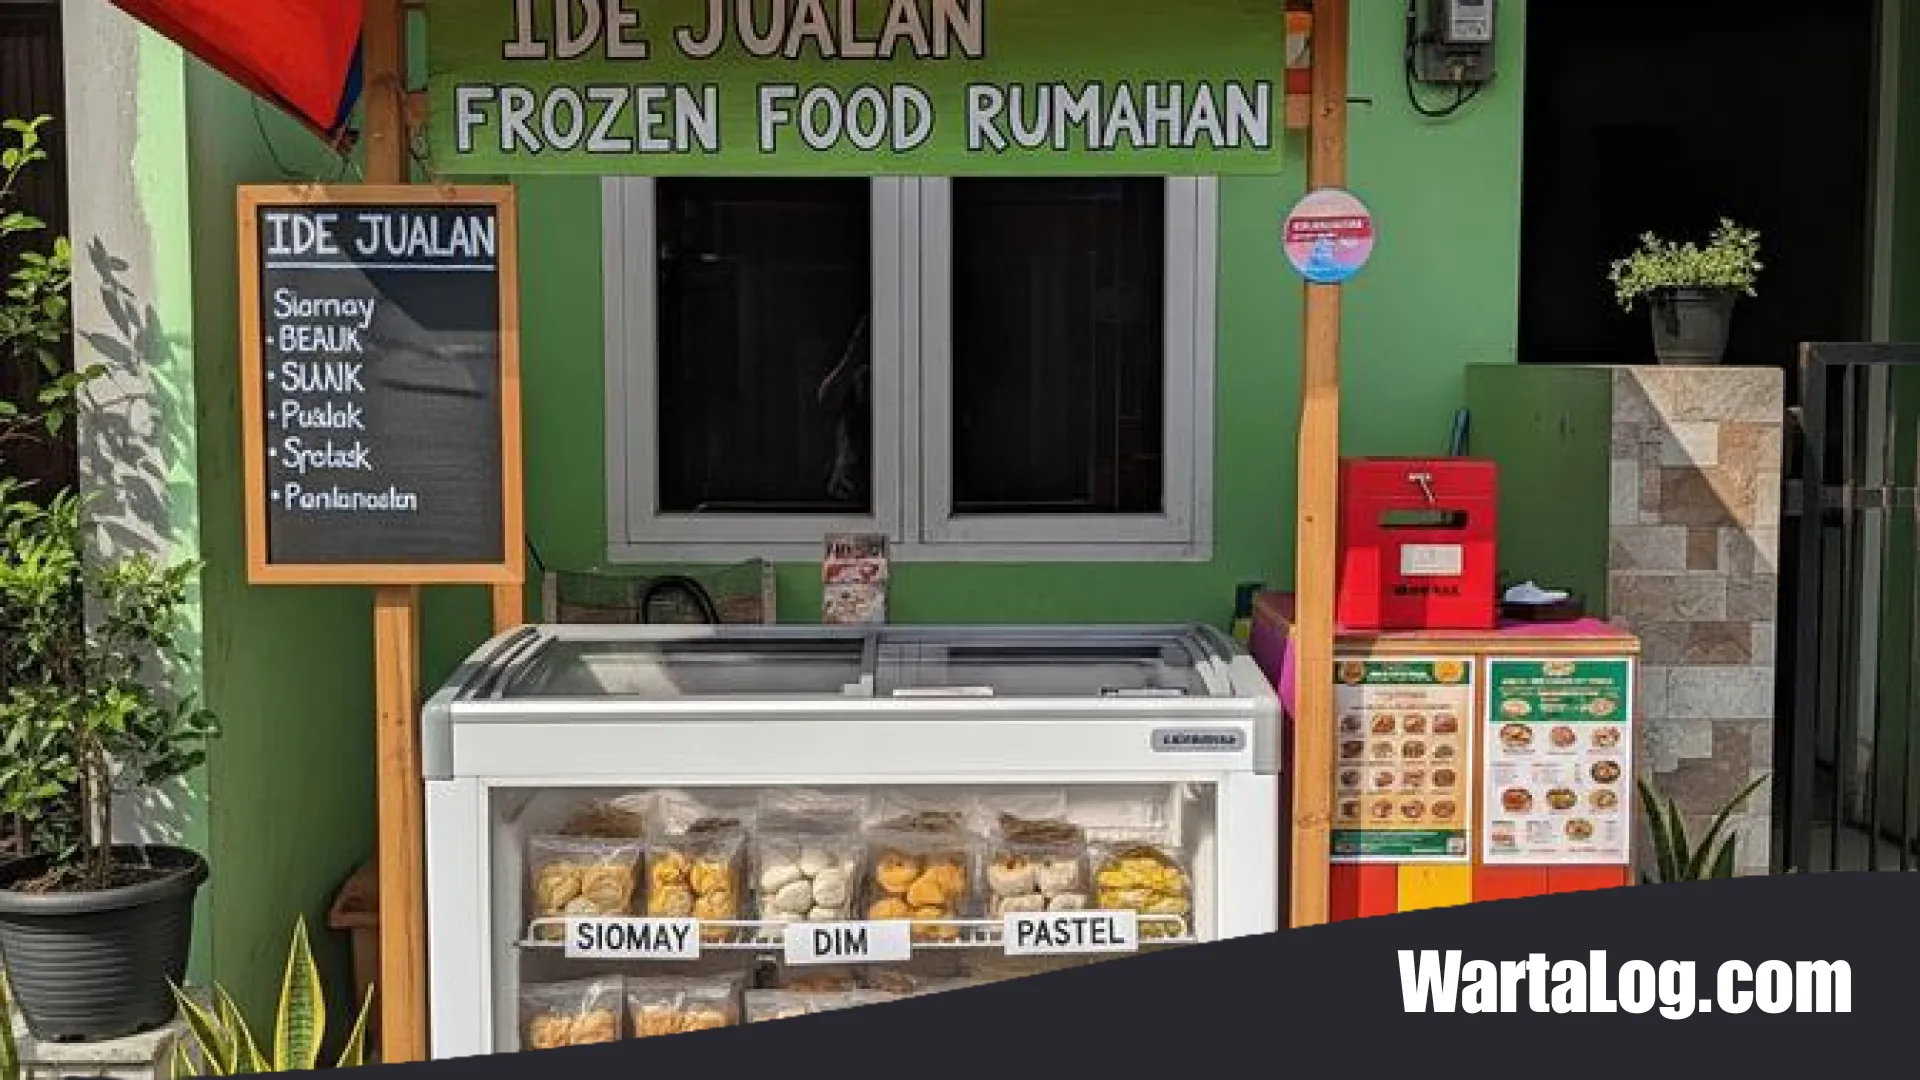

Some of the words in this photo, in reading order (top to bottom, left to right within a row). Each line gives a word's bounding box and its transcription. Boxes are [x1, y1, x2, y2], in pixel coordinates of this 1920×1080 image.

[502, 0, 650, 60] IDE
[674, 0, 985, 60] JUALAN
[454, 83, 718, 153] FROZEN
[757, 82, 933, 153] FOOD
[966, 82, 1272, 151] RUMAHAN
[265, 213, 341, 255] IDE
[355, 213, 496, 258] JUALAN
[576, 922, 693, 954] SIOMAY
[813, 928, 869, 957] DIM
[1016, 915, 1126, 948] PASTEL
